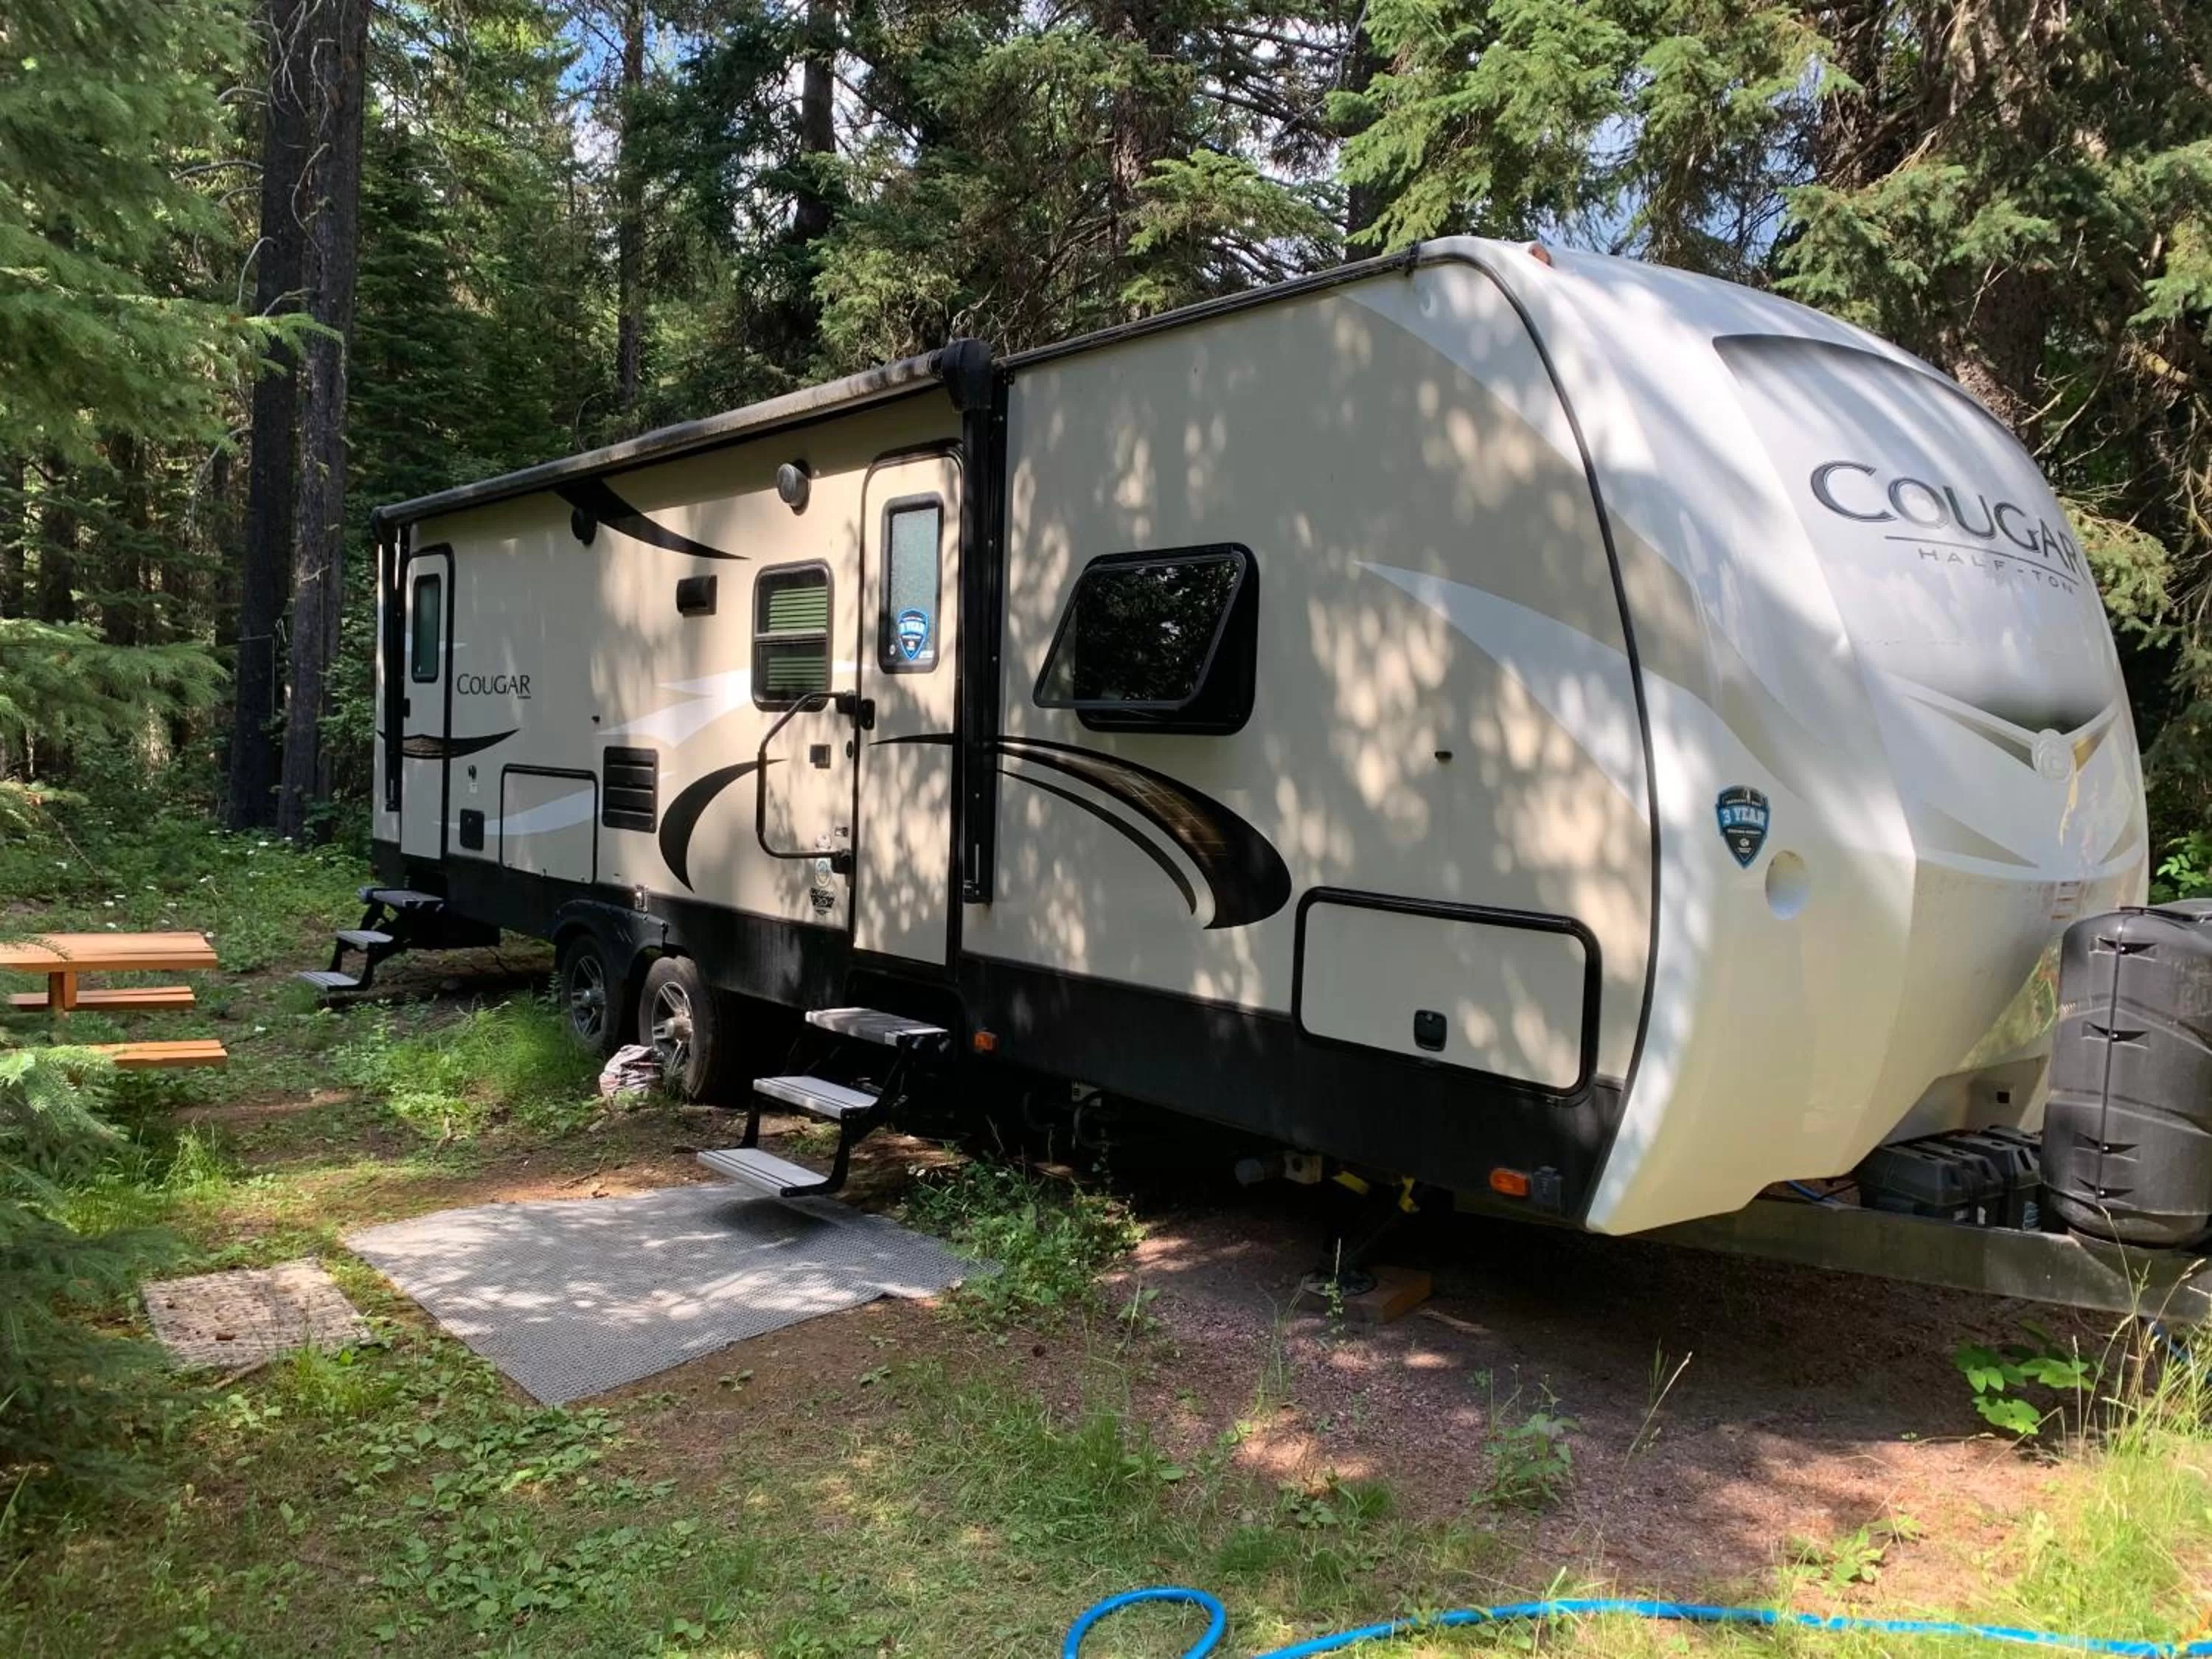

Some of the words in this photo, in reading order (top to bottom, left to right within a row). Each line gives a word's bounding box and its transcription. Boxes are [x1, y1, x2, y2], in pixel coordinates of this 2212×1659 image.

[1810, 460, 2087, 581] COUGAR
[1918, 547, 2074, 595] HALF-TON
[457, 673, 531, 695] COUGAR
[1733, 807, 1766, 827] YEAR
